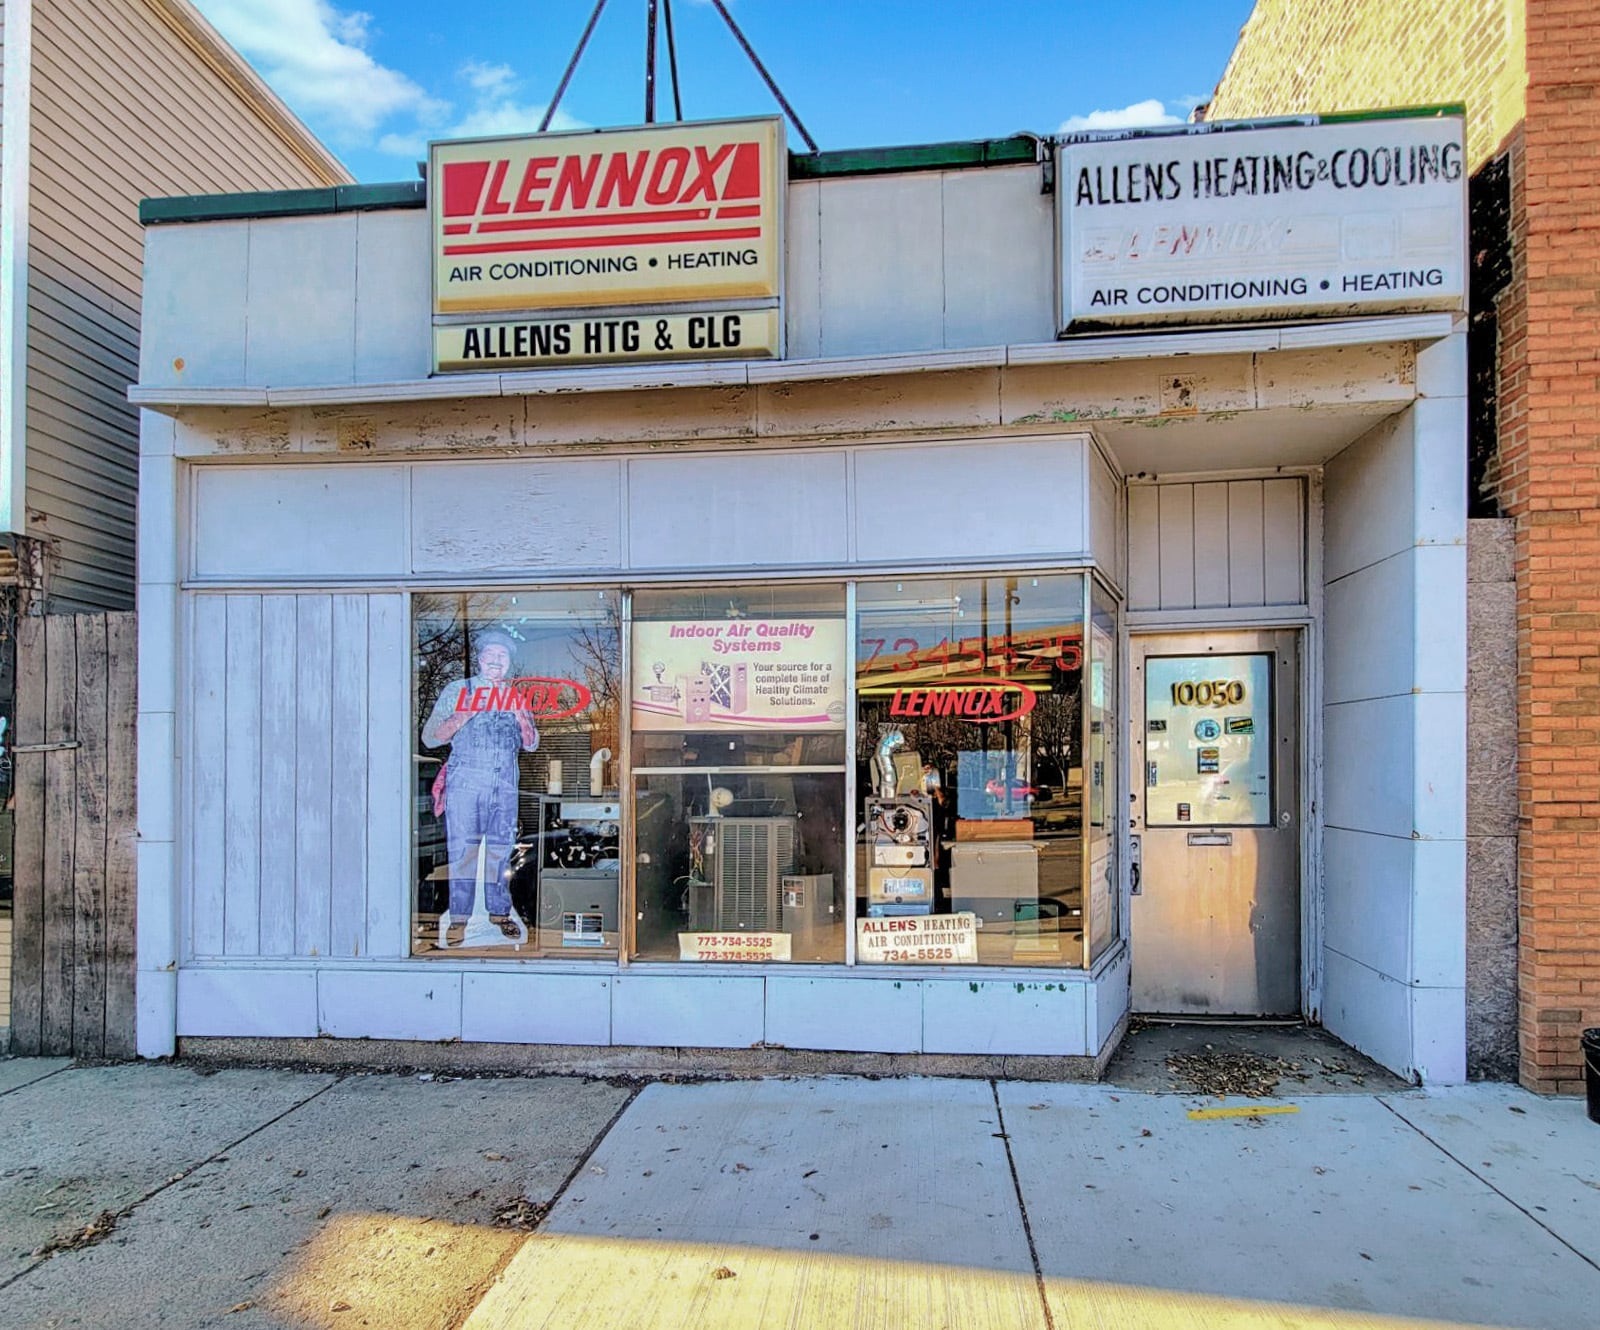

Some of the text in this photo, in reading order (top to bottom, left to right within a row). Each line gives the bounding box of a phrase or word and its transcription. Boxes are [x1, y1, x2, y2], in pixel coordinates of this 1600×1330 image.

[481, 143, 736, 216] LENNOX
[1075, 159, 1181, 206] ALLENS
[449, 249, 758, 282] AIR CONDITIONING HEATING
[1090, 269, 1443, 306] AIR CONDITIONING HEATING
[462, 315, 741, 359] ALLENS HTG & CLG
[670, 622, 815, 639] Indoor Air Quality
[713, 639, 782, 654] Systems
[753, 662, 832, 672] Your source for a
[755, 672, 830, 684] complete line of
[455, 685, 564, 713] LENNOX
[755, 684, 828, 696] Healthy Climate
[1171, 680, 1246, 708] 10050
[890, 686, 1005, 717] LENNOX
[863, 918, 971, 933] ALLEN'S HEATING
[868, 932, 966, 948] AIR CONDITIONING
[882, 947, 953, 961] 734-5525
